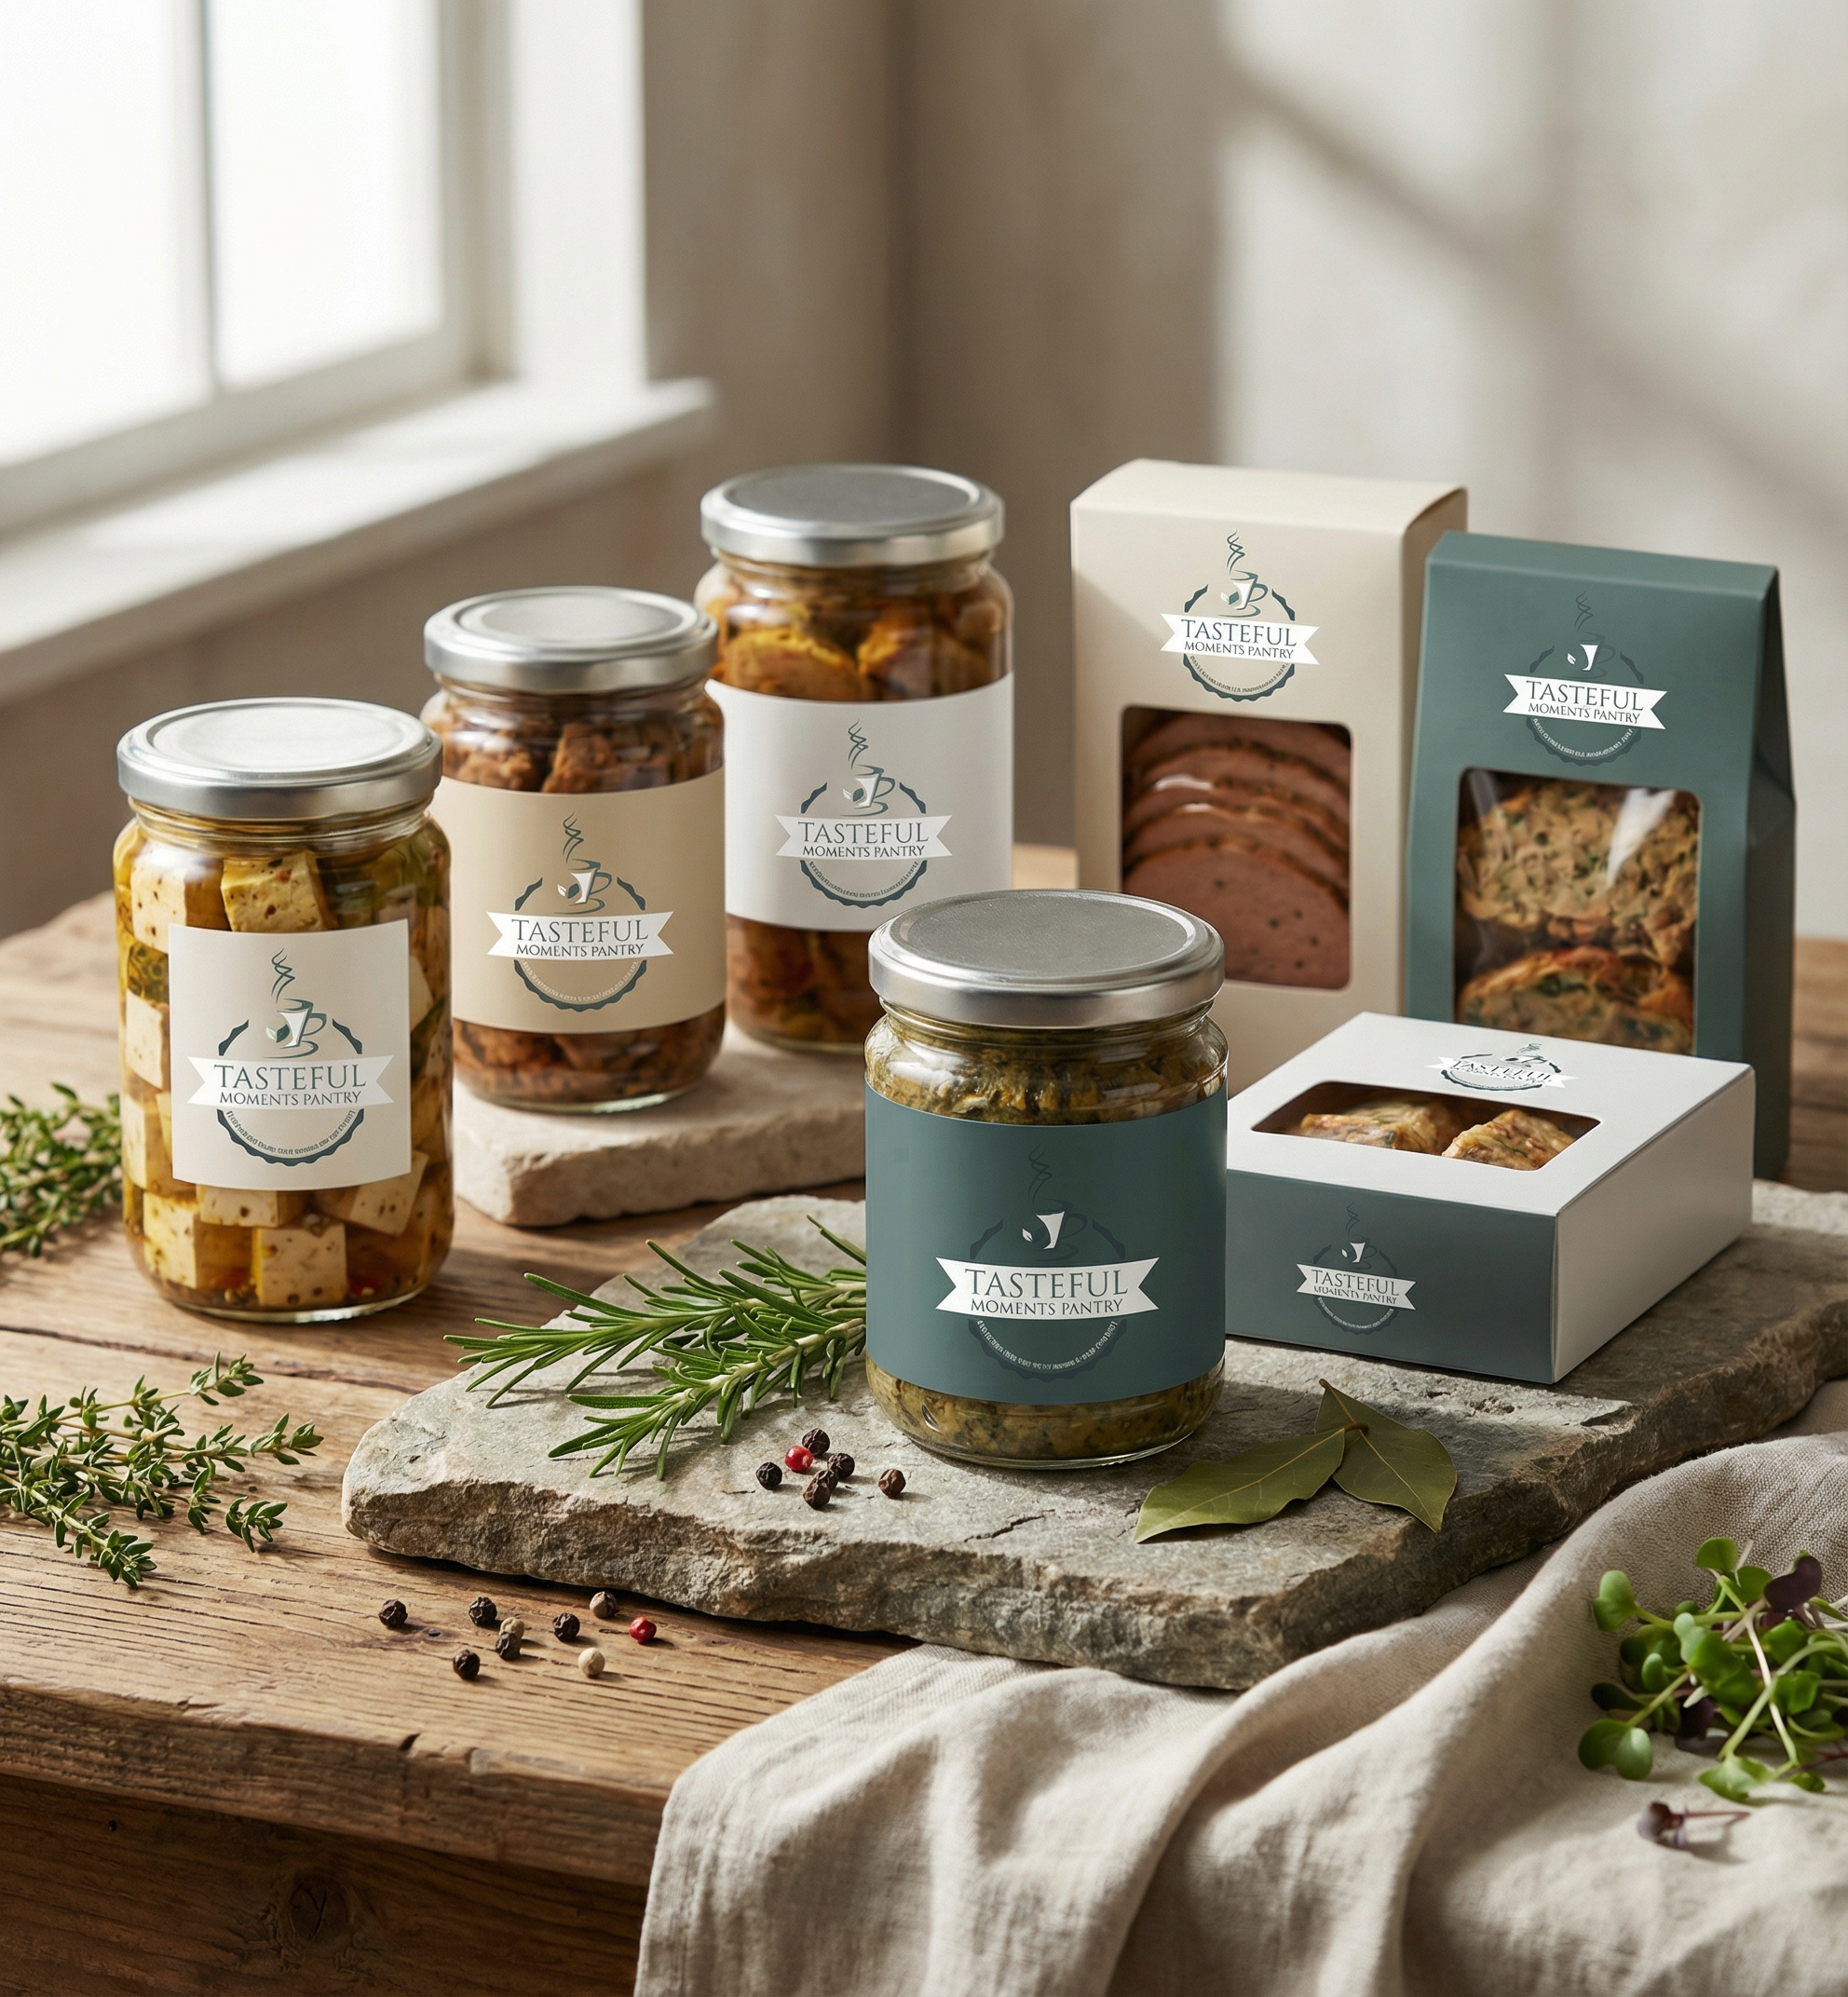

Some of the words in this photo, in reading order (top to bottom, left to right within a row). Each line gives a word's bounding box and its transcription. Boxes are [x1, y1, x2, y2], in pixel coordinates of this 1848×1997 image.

[1181, 618, 1297, 647] TASTEFUL
[1184, 641, 1244, 656] MOMENTS
[1248, 645, 1294, 659] PANTRY
[1526, 680, 1644, 711] TASTEFUL
[1528, 702, 1590, 718] MOMENTS
[1594, 709, 1640, 725] PANTRY
[798, 822, 929, 844] TASTEFUL
[802, 845, 870, 858] MOMENTS
[875, 845, 925, 858] PANTRY
[511, 918, 648, 943] TASTEFUL
[516, 944, 587, 958] MOMENTS
[591, 943, 645, 957] PANTRY
[213, 1064, 366, 1090] TASTEFUL
[219, 1092, 299, 1106] MOMENTS
[304, 1091, 361, 1106] PANTRY
[965, 1269, 1128, 1298] TASTEFUL
[1311, 1270, 1399, 1296] TASTEFUL
[971, 1298, 1055, 1316] MOMENTS
[1062, 1298, 1123, 1315] PANTRY
